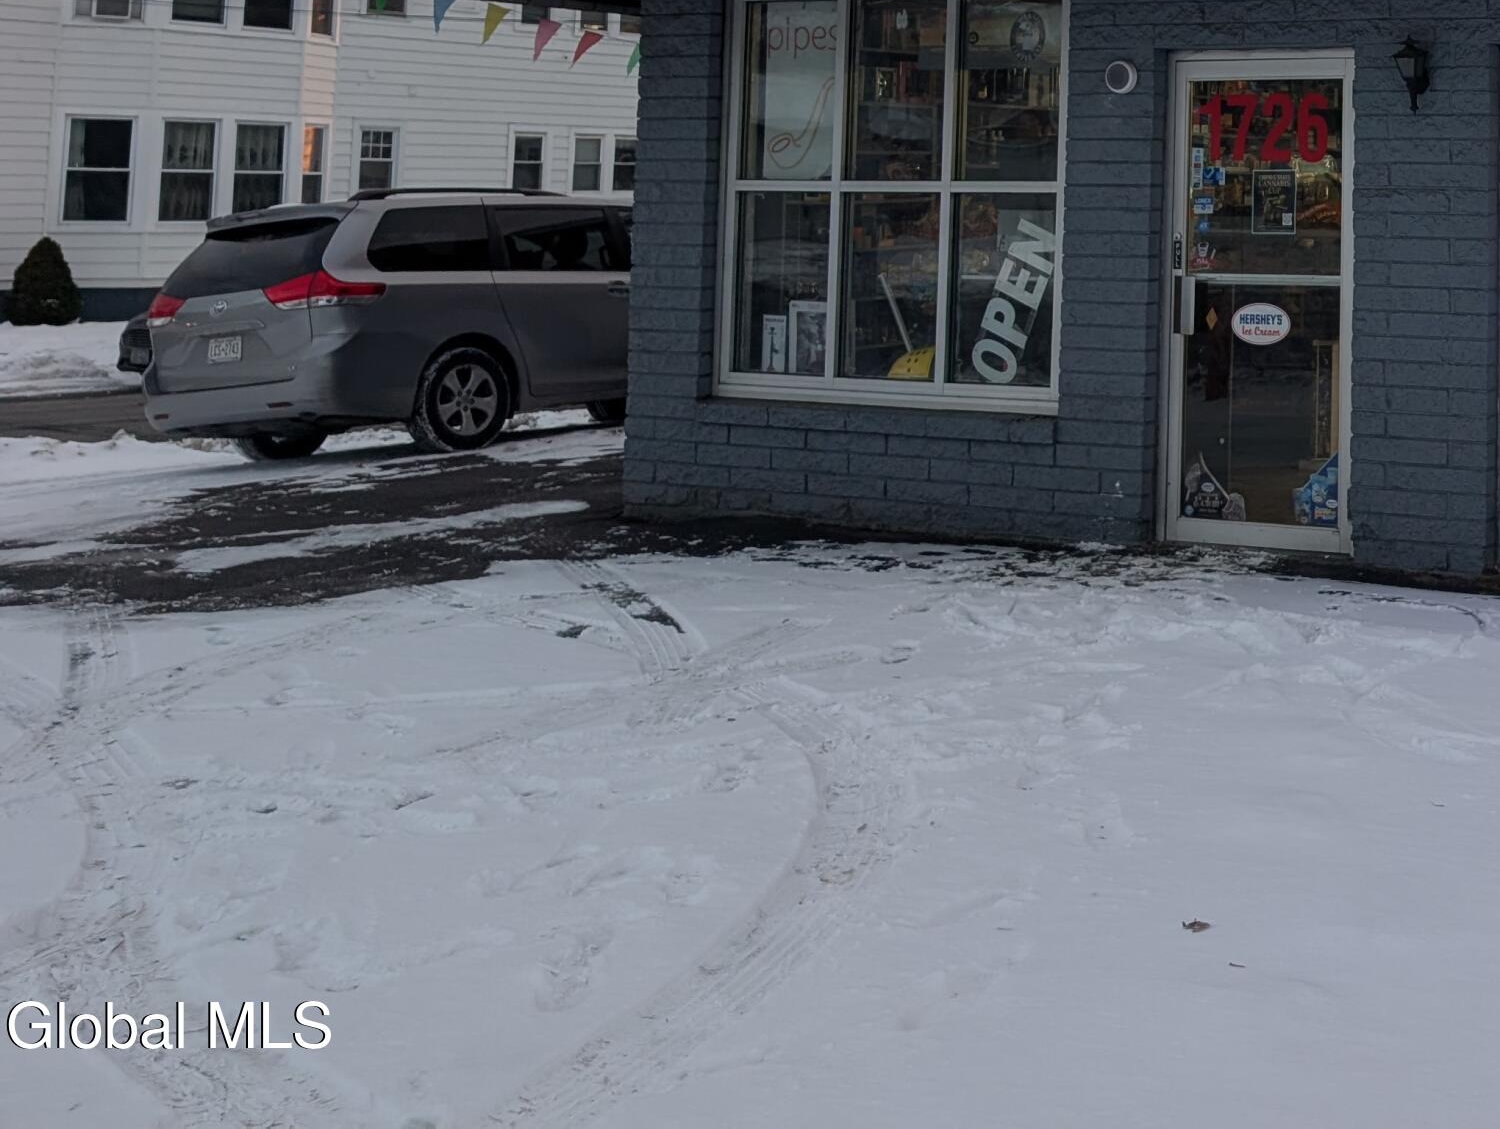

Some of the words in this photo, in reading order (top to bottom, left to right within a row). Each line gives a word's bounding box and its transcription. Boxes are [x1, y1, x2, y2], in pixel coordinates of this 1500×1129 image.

[768, 16, 838, 59] pipes
[1199, 92, 1329, 163] 1726
[971, 217, 1057, 384] OPEN
[1239, 313, 1283, 325] HERSHEY'S
[1242, 325, 1253, 336] Ice
[1254, 326, 1280, 337] Cream
